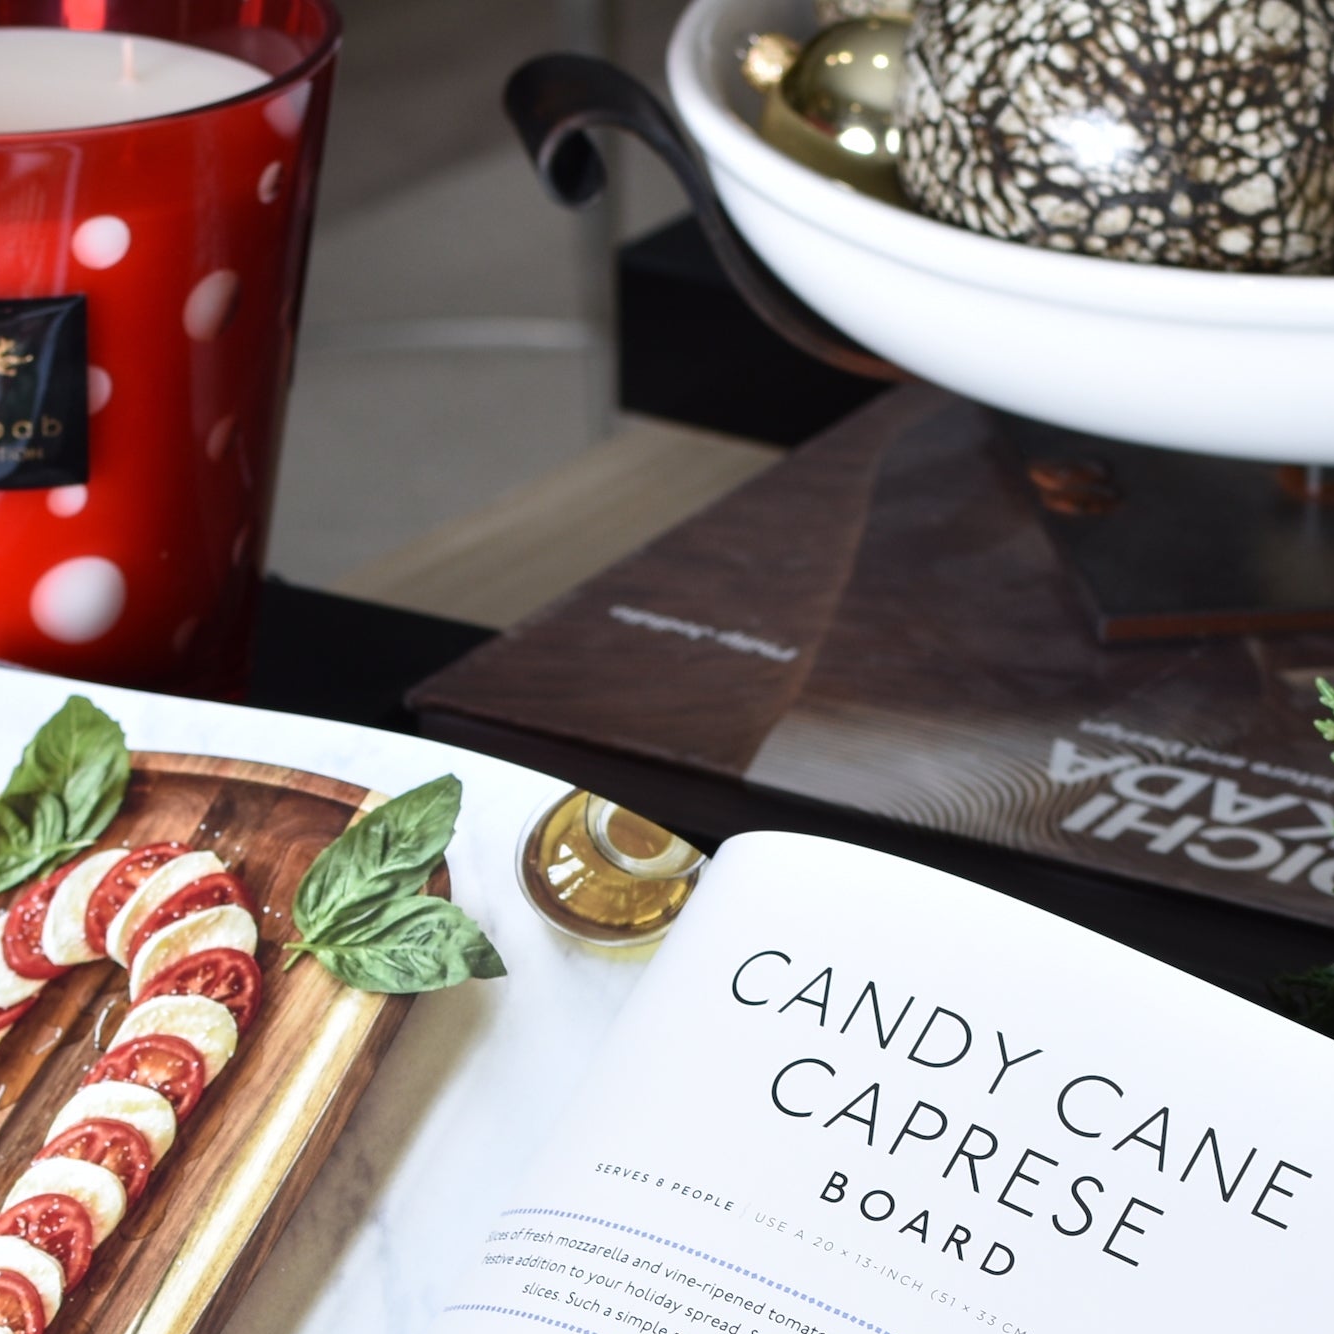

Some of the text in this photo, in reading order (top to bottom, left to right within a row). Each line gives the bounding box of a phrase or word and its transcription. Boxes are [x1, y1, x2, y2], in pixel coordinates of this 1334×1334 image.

[732, 951, 1312, 1229] CANDY CANE
[772, 1059, 1164, 1266] CAPRESE
[509, 1227, 526, 1241] of
[522, 1227, 554, 1244] fresh
[555, 1236, 630, 1264] mozzarella
[631, 1257, 664, 1275] and
[664, 1267, 767, 1315] vine-ripened
[594, 1162, 651, 1183] SERVES
[655, 1177, 665, 1188] 8
[670, 1182, 735, 1212] PEOPLE
[754, 1211, 788, 1233] USE
[792, 1228, 804, 1241] A
[810, 1236, 834, 1252] 20
[854, 1253, 924, 1293] 13-INCH
[930, 1288, 957, 1308] (51
[971, 1309, 998, 1328] 33
[820, 1171, 1014, 1275] BOARD
[483, 1252, 515, 1265] festive
[514, 1254, 567, 1274] addition
[569, 1265, 585, 1279] to
[583, 1271, 624, 1290] your
[623, 1280, 684, 1315] holiday
[521, 1281, 561, 1302] slices.
[564, 1291, 601, 1313] Such
[602, 1306, 613, 1317] a
